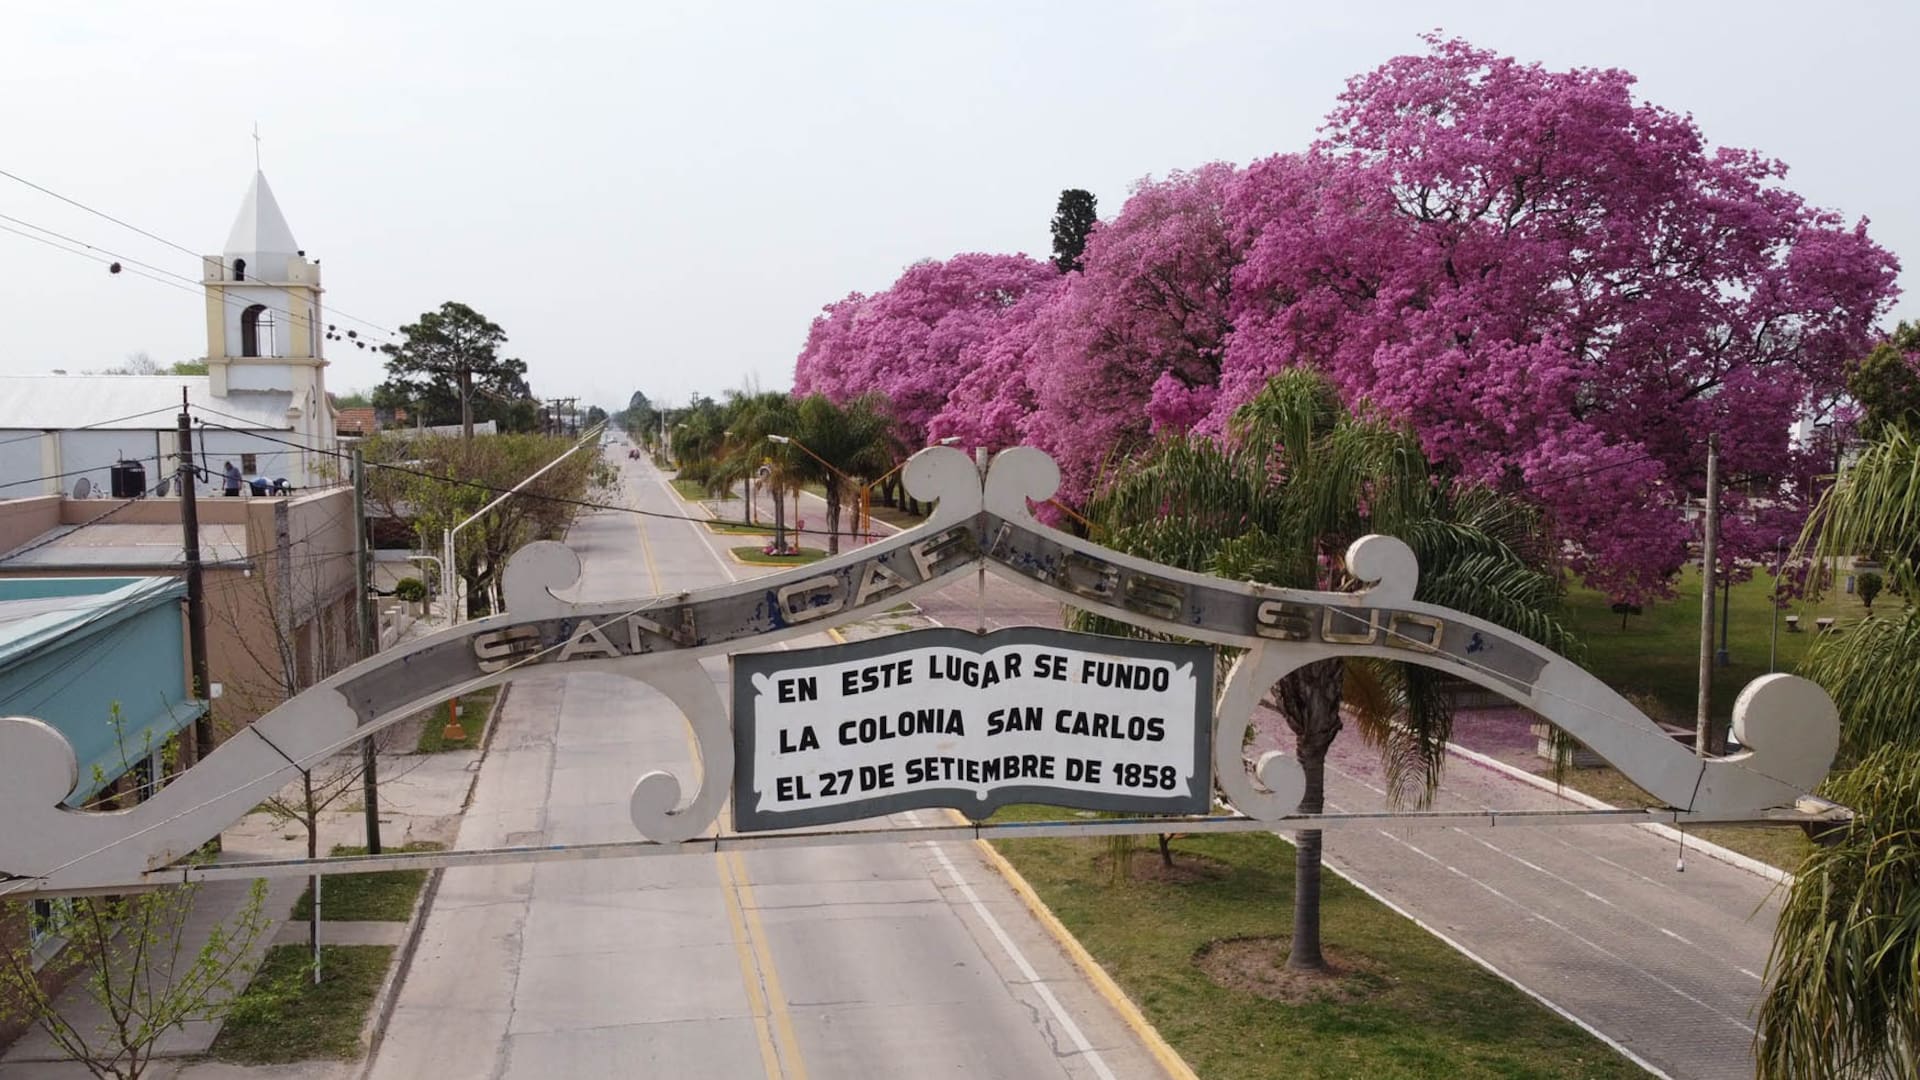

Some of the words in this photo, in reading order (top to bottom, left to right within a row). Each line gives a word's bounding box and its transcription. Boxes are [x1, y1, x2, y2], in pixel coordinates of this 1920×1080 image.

[474, 606, 698, 674] SAN
[1256, 600, 1445, 653] SUD
[778, 676, 818, 704] EN
[842, 659, 913, 697] ESTE
[929, 652, 1022, 690] LUGAR
[1033, 654, 1068, 682] SE
[1081, 660, 1170, 693] FUNDO
[779, 725, 820, 755] LA
[838, 708, 965, 747] COLONIA
[987, 706, 1043, 738] SAN
[1055, 709, 1165, 743] CARLOS
[776, 775, 812, 802] EL
[819, 768, 855, 798] 27
[859, 763, 896, 792] DE
[905, 754, 1055, 785] SETIEMBRE
[1065, 758, 1102, 784] DE
[1112, 763, 1177, 791] 1858
